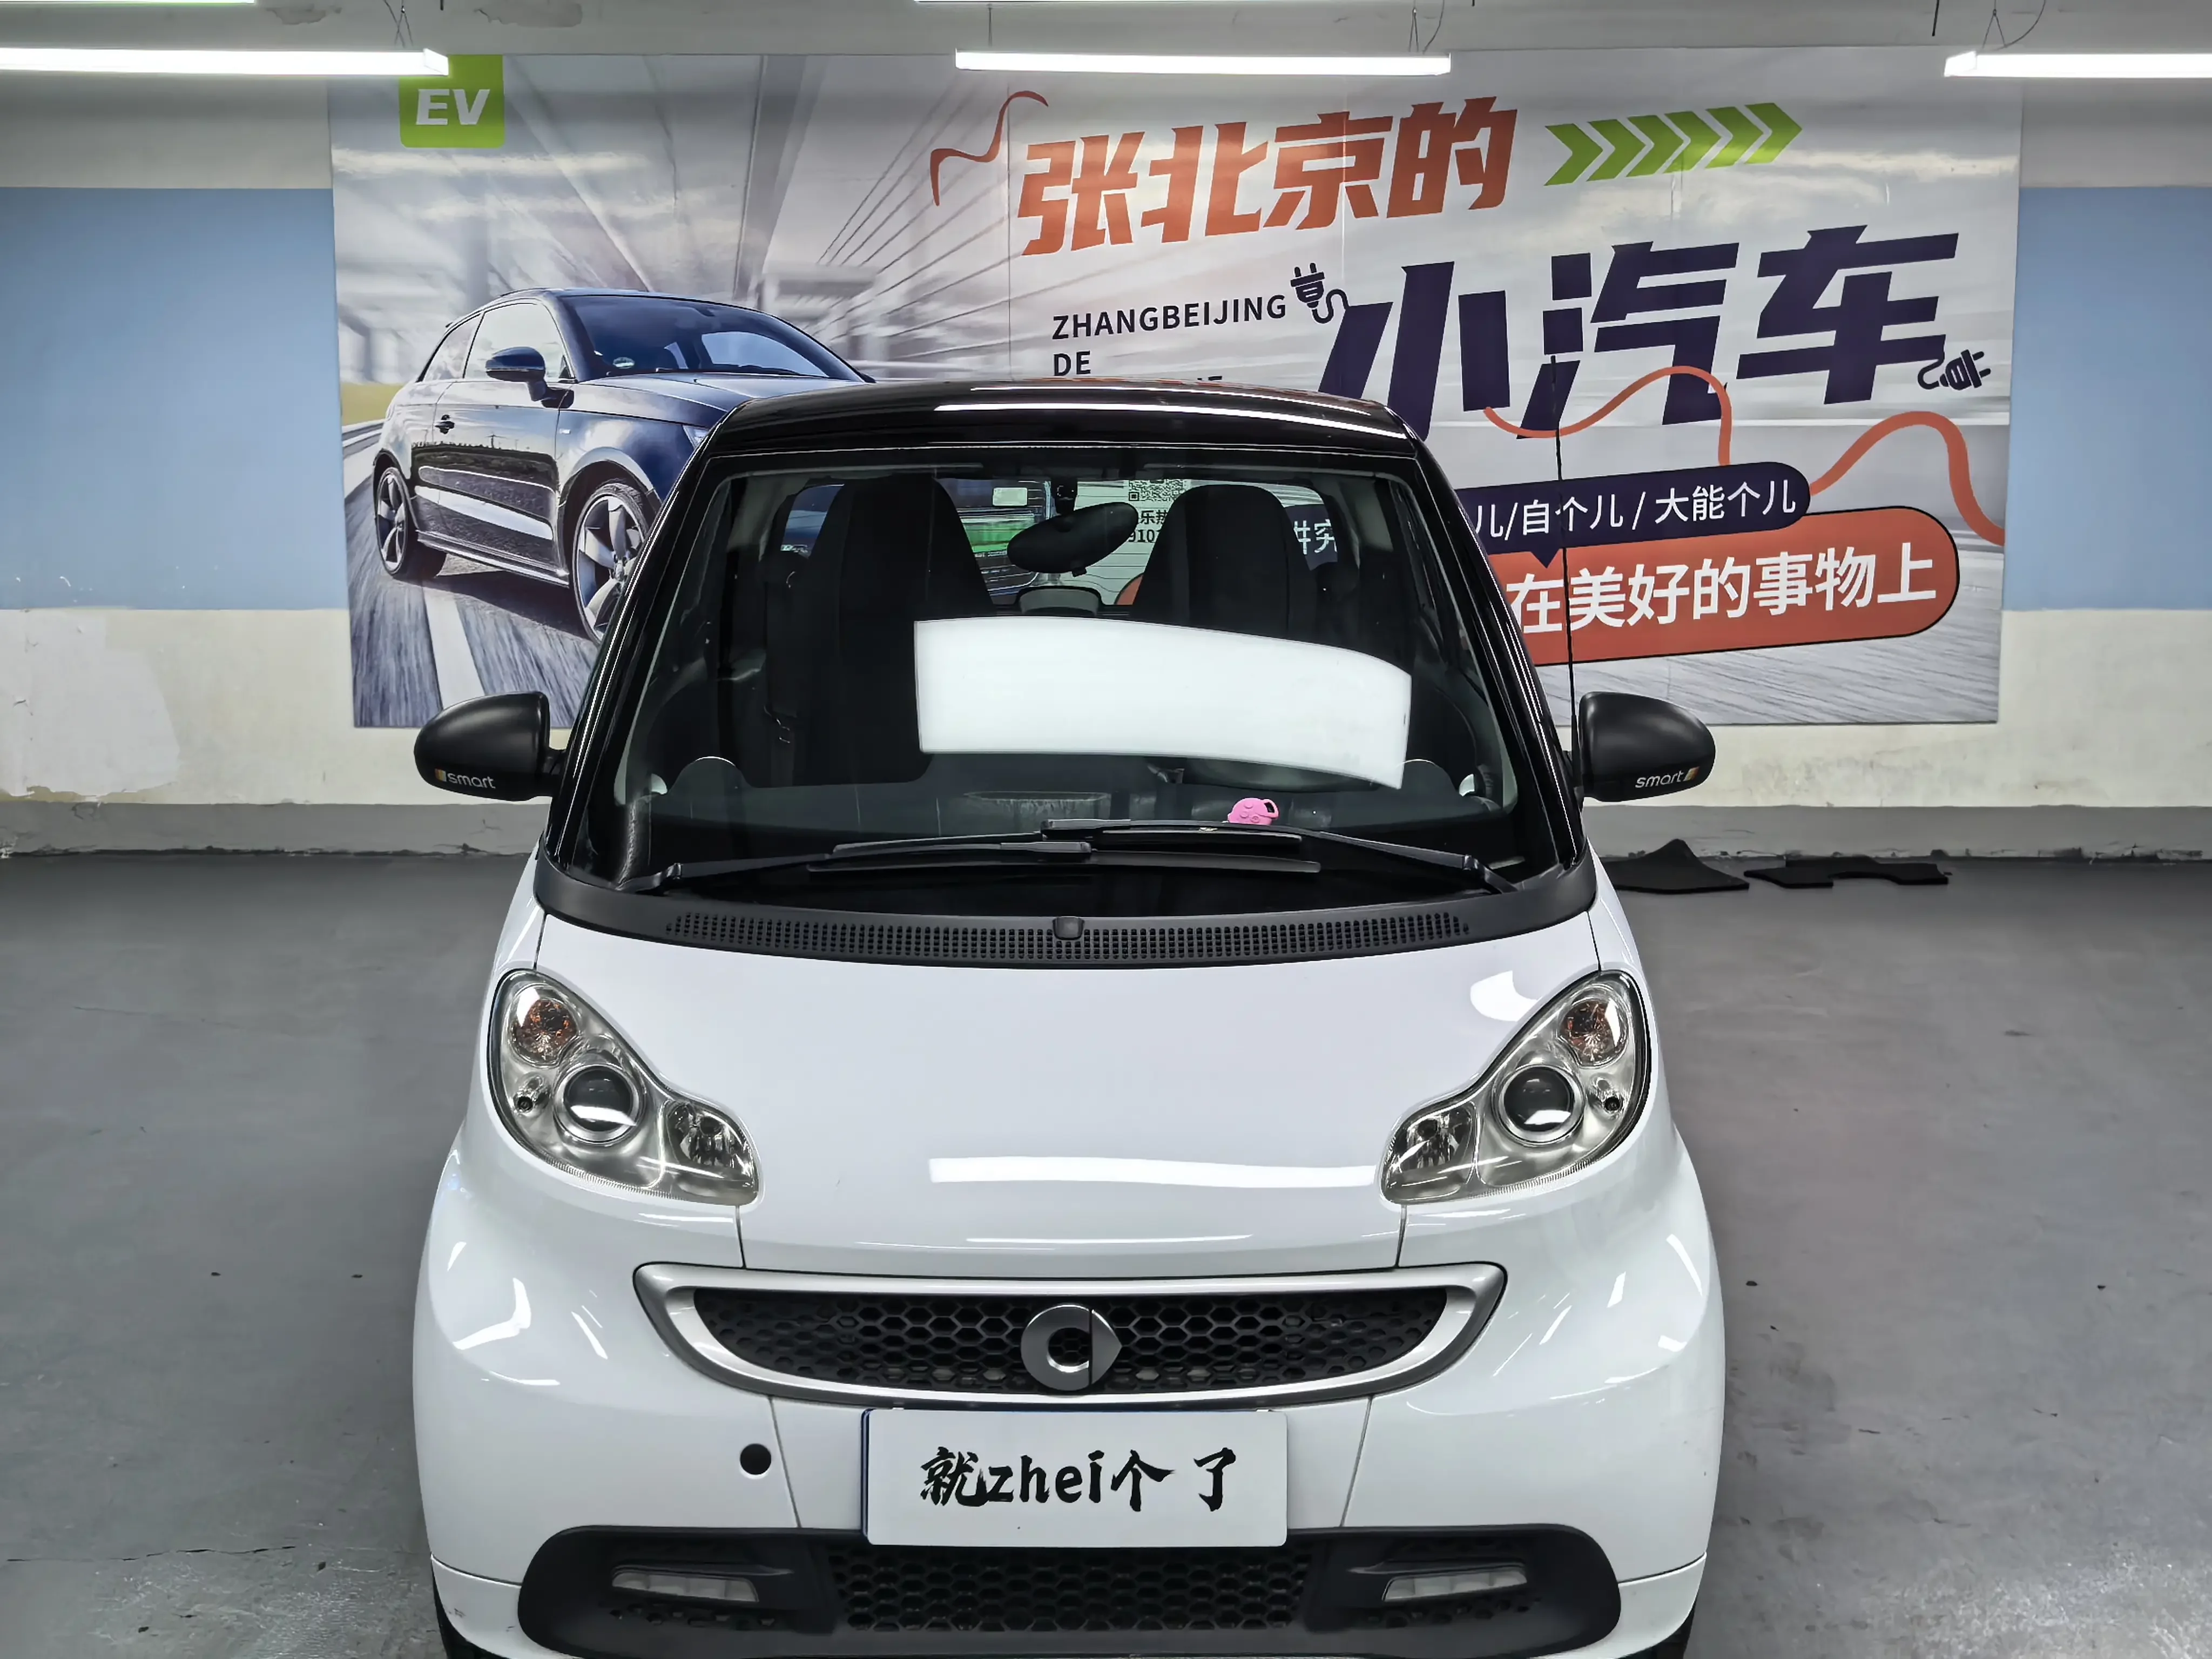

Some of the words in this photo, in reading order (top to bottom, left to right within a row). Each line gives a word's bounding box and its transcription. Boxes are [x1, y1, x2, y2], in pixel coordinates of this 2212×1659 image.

[416, 89, 490, 126] EV
[1017, 96, 1518, 256] 张北京的
[1052, 294, 1287, 340] ZHANGBEIJING
[1318, 224, 1959, 440] 小汽车
[1053, 350, 1091, 376] DE
[1506, 542, 1936, 634] 在美好的事物上
[447, 773, 496, 788] smart
[1635, 770, 1684, 788] smart
